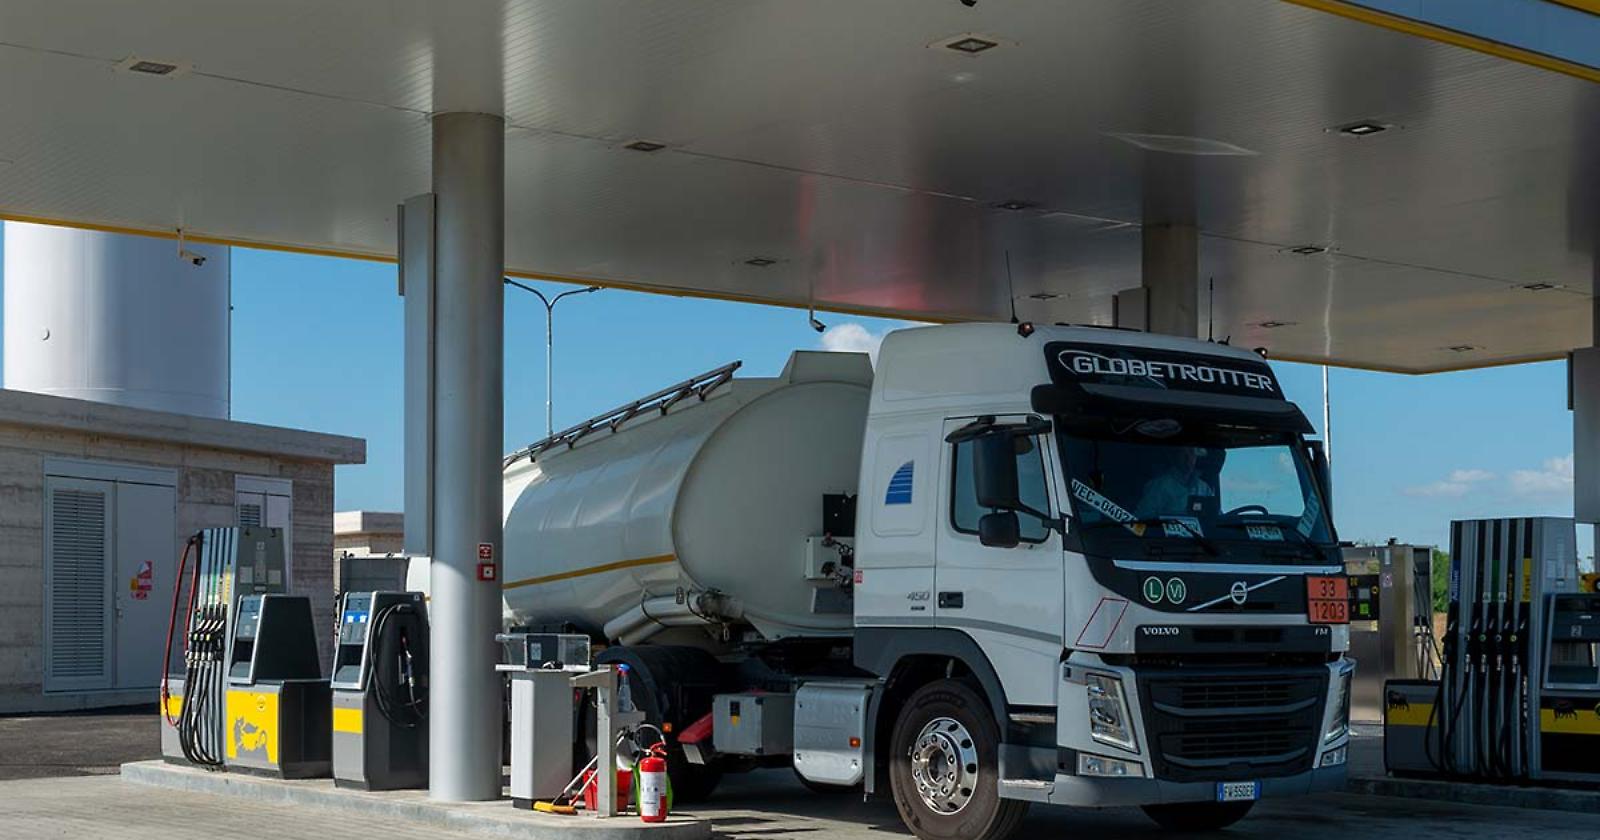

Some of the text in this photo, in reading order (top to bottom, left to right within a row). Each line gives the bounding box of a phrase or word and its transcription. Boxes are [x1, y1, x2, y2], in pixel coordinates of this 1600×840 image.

[1072, 356, 1275, 392] GLOBETROTTER
[1320, 580, 1336, 597] 33
[1314, 603, 1345, 619] 1203
[1142, 627, 1180, 636] VOLVO
